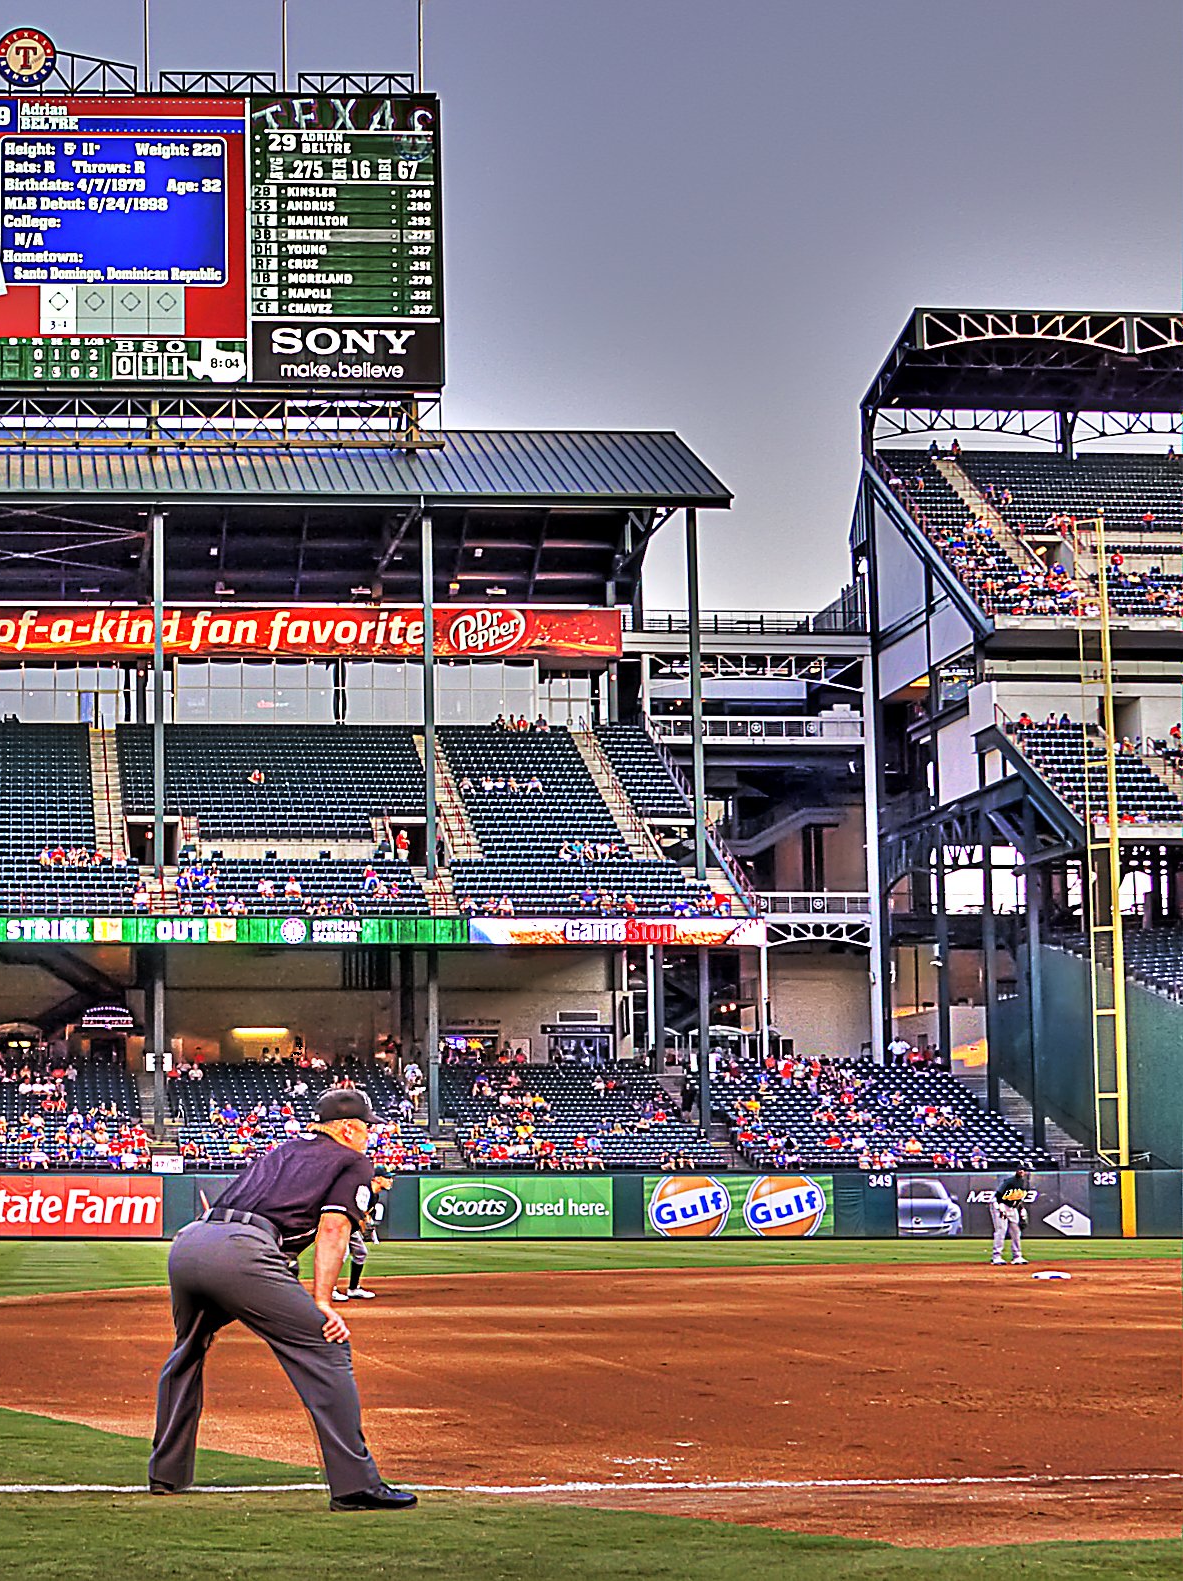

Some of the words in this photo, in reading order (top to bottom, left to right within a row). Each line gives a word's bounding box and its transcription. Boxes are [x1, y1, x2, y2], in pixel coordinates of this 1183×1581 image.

[15, 46, 37, 69] T
[21, 103, 67, 115] Adrian
[21, 117, 79, 130] BELTRE
[268, 134, 297, 151] 29
[301, 133, 343, 142] ADRIAN
[5, 142, 56, 158] Height:
[135, 142, 189, 158] Weight:
[192, 143, 222, 156] 220
[302, 143, 351, 154] BELTRE
[5, 160, 41, 174] Bats:
[44, 161, 55, 173] R
[72, 160, 131, 174] Throws:
[134, 161, 145, 173] R
[289, 160, 323, 179] .275
[351, 160, 371, 179] 16
[397, 160, 418, 180] 67
[5, 178, 74, 192] Birthdate:
[77, 178, 146, 194] 4/7/1979
[167, 179, 199, 195] Age:
[201, 179, 222, 192] 32
[287, 186, 337, 198] KINSLER
[4, 197, 37, 210] MLB
[40, 197, 85, 210] Debut:
[287, 200, 335, 212] ANDRUS
[4, 215, 61, 230] College:
[287, 216, 349, 226] HAMILTON
[14, 233, 44, 248] N/A
[3, 250, 83, 263] Hometown:
[287, 244, 328, 255] YOUNG
[287, 258, 319, 270] CRUZ
[14, 267, 48, 280] Santo
[50, 267, 104, 282] Domingo,
[106, 267, 169, 280] Dominican
[171, 267, 222, 282] Republic
[287, 273, 353, 284] MORELAND
[287, 303, 333, 314] CHAVEZ
[115, 340, 135, 352] B
[142, 340, 159, 352] S
[166, 340, 185, 352] O
[271, 328, 416, 355] SONY
[33, 349, 43, 361] 0
[69, 349, 81, 361] 0
[89, 349, 99, 361] 2
[117, 356, 132, 374] 0
[146, 357, 155, 374] 1
[171, 357, 180, 374] 1
[210, 358, 240, 369] 8:04
[280, 362, 404, 378] make.believe
[33, 366, 43, 378] 2
[69, 366, 81, 378] 0
[89, 366, 99, 378] 2
[475, 610, 503, 632] Dr
[189, 610, 258, 652] fan
[267, 610, 424, 652] favorite
[449, 615, 520, 652] Pepper
[7, 919, 90, 940] STRIKE
[156, 920, 205, 940] OUT
[313, 920, 363, 932] OFFICIAL
[566, 919, 676, 942] GameStop
[313, 932, 358, 942] SCORER
[869, 1174, 892, 1188] 349
[1093, 1172, 1117, 1186] 325
[66, 1188, 161, 1224] Farm
[436, 1196, 508, 1217] Scotts
[526, 1200, 563, 1217] used
[567, 1200, 610, 1217] here.
[655, 1190, 725, 1225] Gulf
[750, 1190, 821, 1225] Gulf
